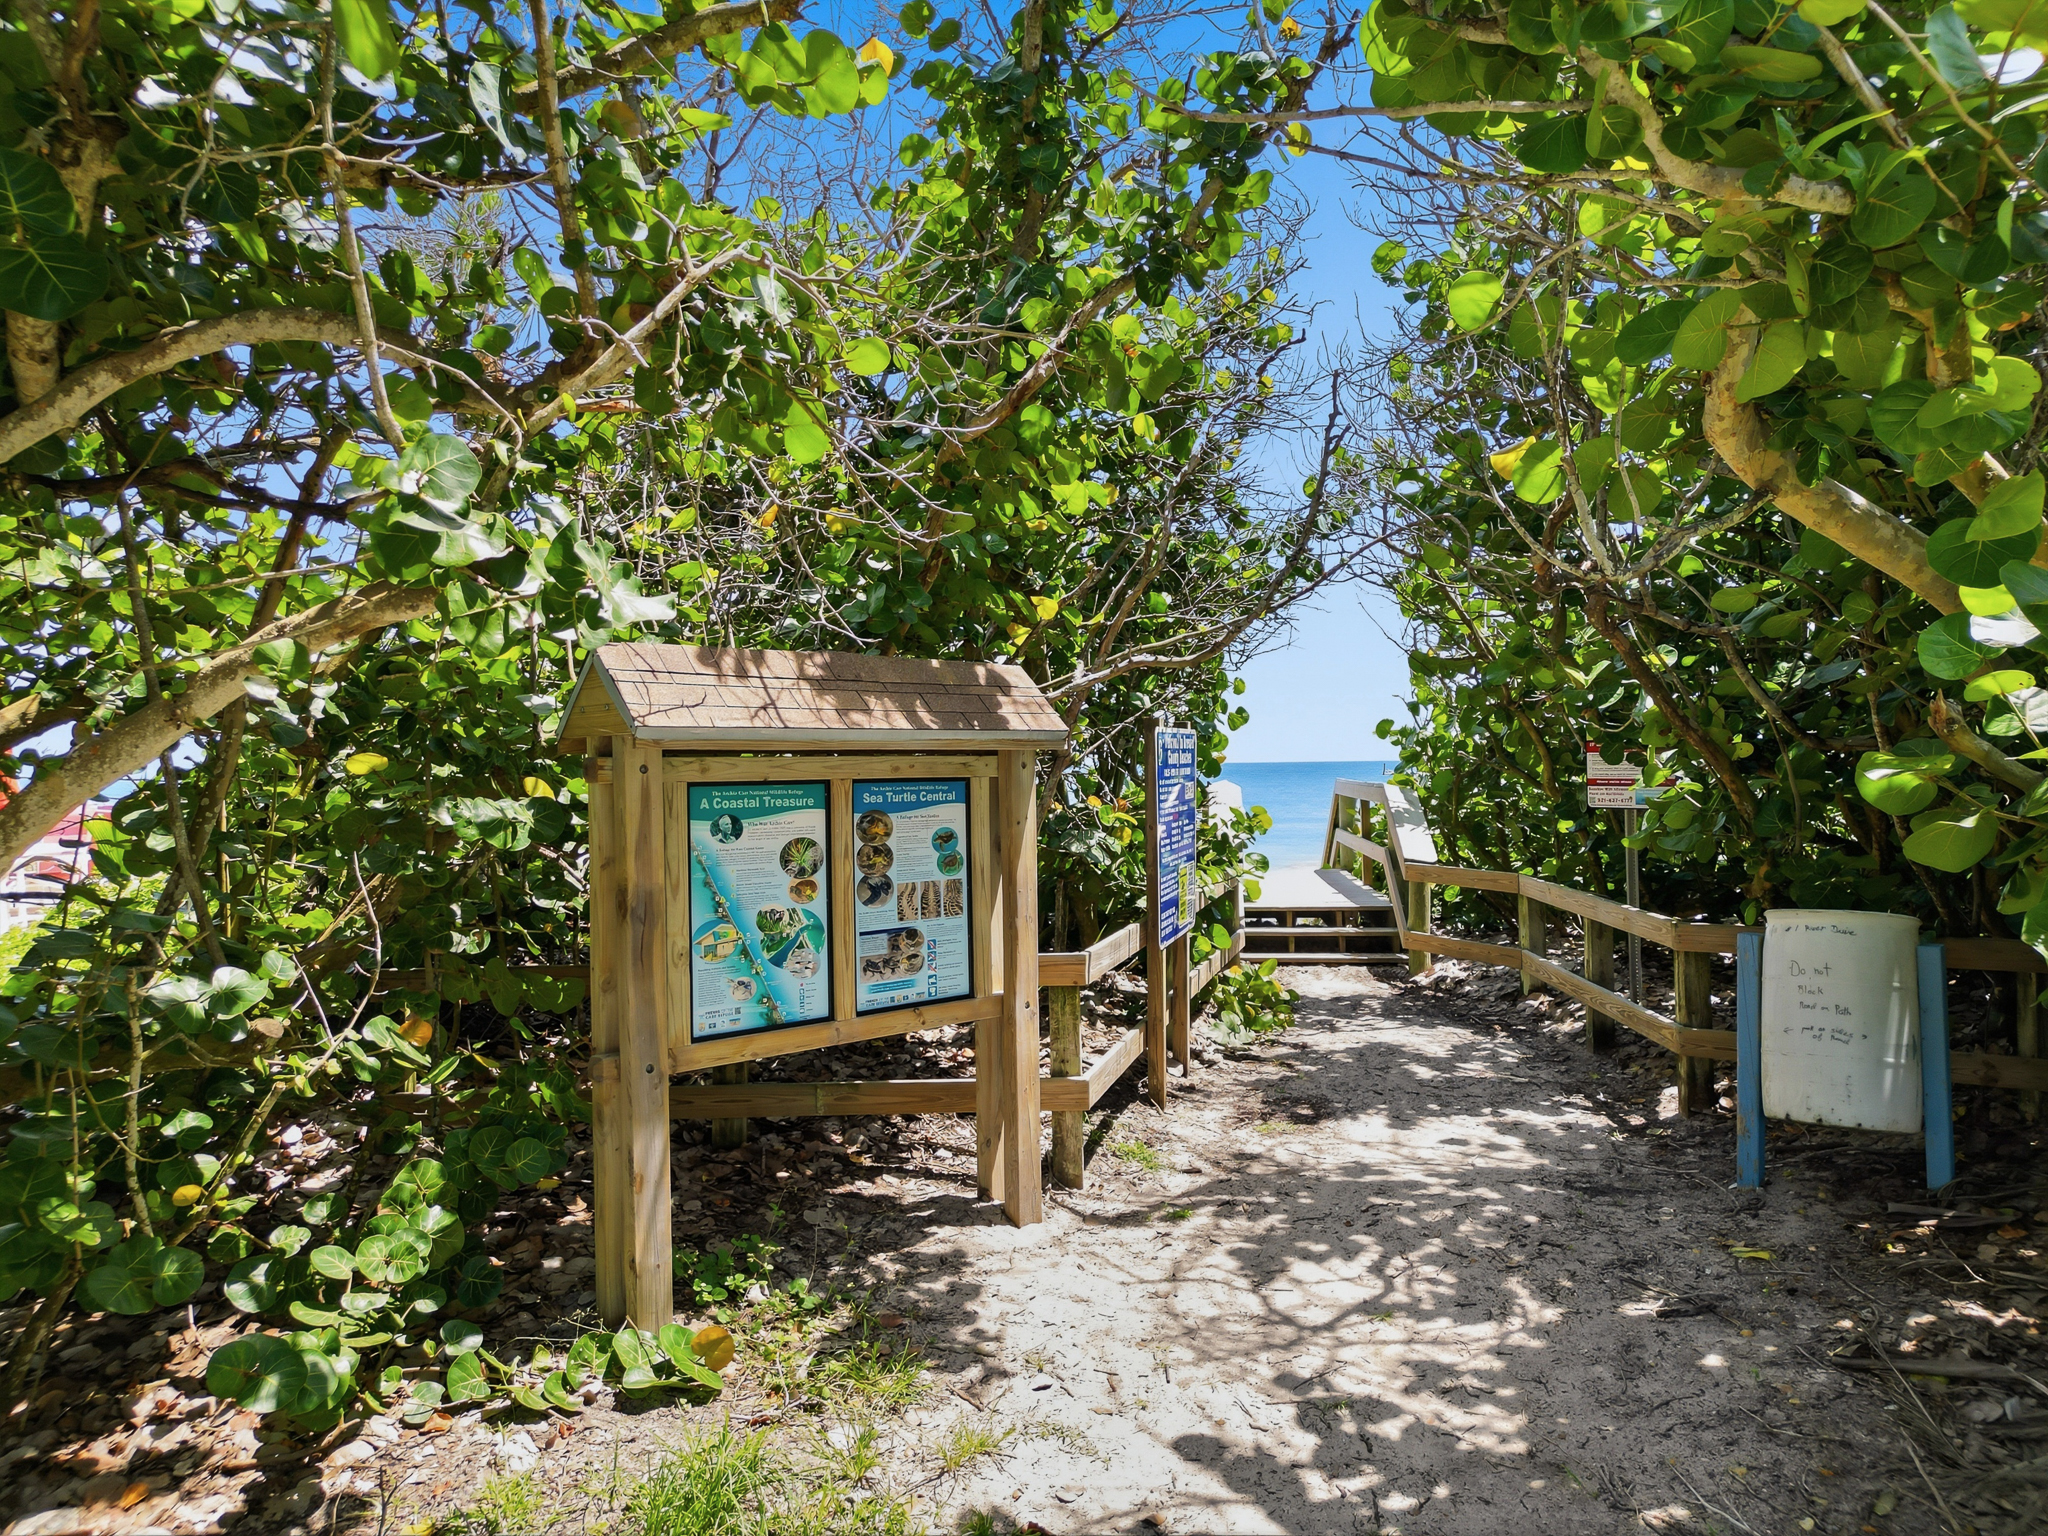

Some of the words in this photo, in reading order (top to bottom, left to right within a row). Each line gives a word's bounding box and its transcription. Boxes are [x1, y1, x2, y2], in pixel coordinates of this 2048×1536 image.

[700, 798, 710, 809] A
[713, 797, 760, 809] Coastal
[763, 796, 815, 807] Treasure
[862, 792, 883, 803] Sea
[886, 792, 917, 802] Turtle
[920, 791, 956, 801] Central
[1789, 960, 1806, 977] Do
[1813, 962, 1832, 977] not
[1798, 985, 1824, 995] Block
[1835, 1004, 1852, 1016] Path
